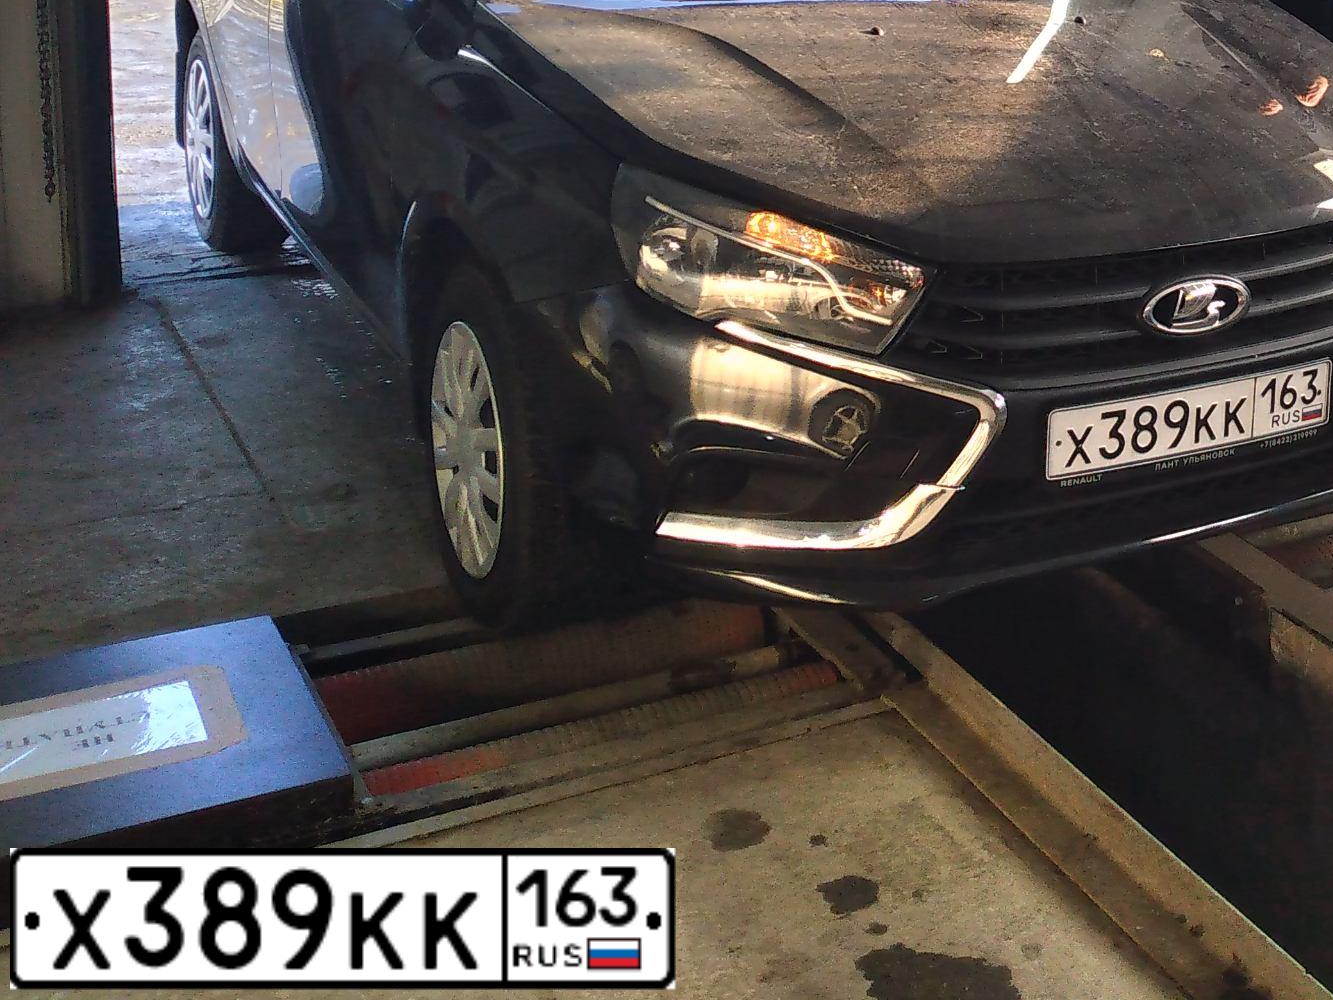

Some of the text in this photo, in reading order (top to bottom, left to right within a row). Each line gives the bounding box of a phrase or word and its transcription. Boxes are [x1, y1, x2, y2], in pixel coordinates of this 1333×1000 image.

[1260, 368, 1319, 415] 163
[1271, 409, 1301, 429] RUS
[1064, 397, 1248, 469] Х389КК
[1183, 448, 1236, 467] УЛЬЯНОВСК
[1060, 473, 1104, 488] RENAULT
